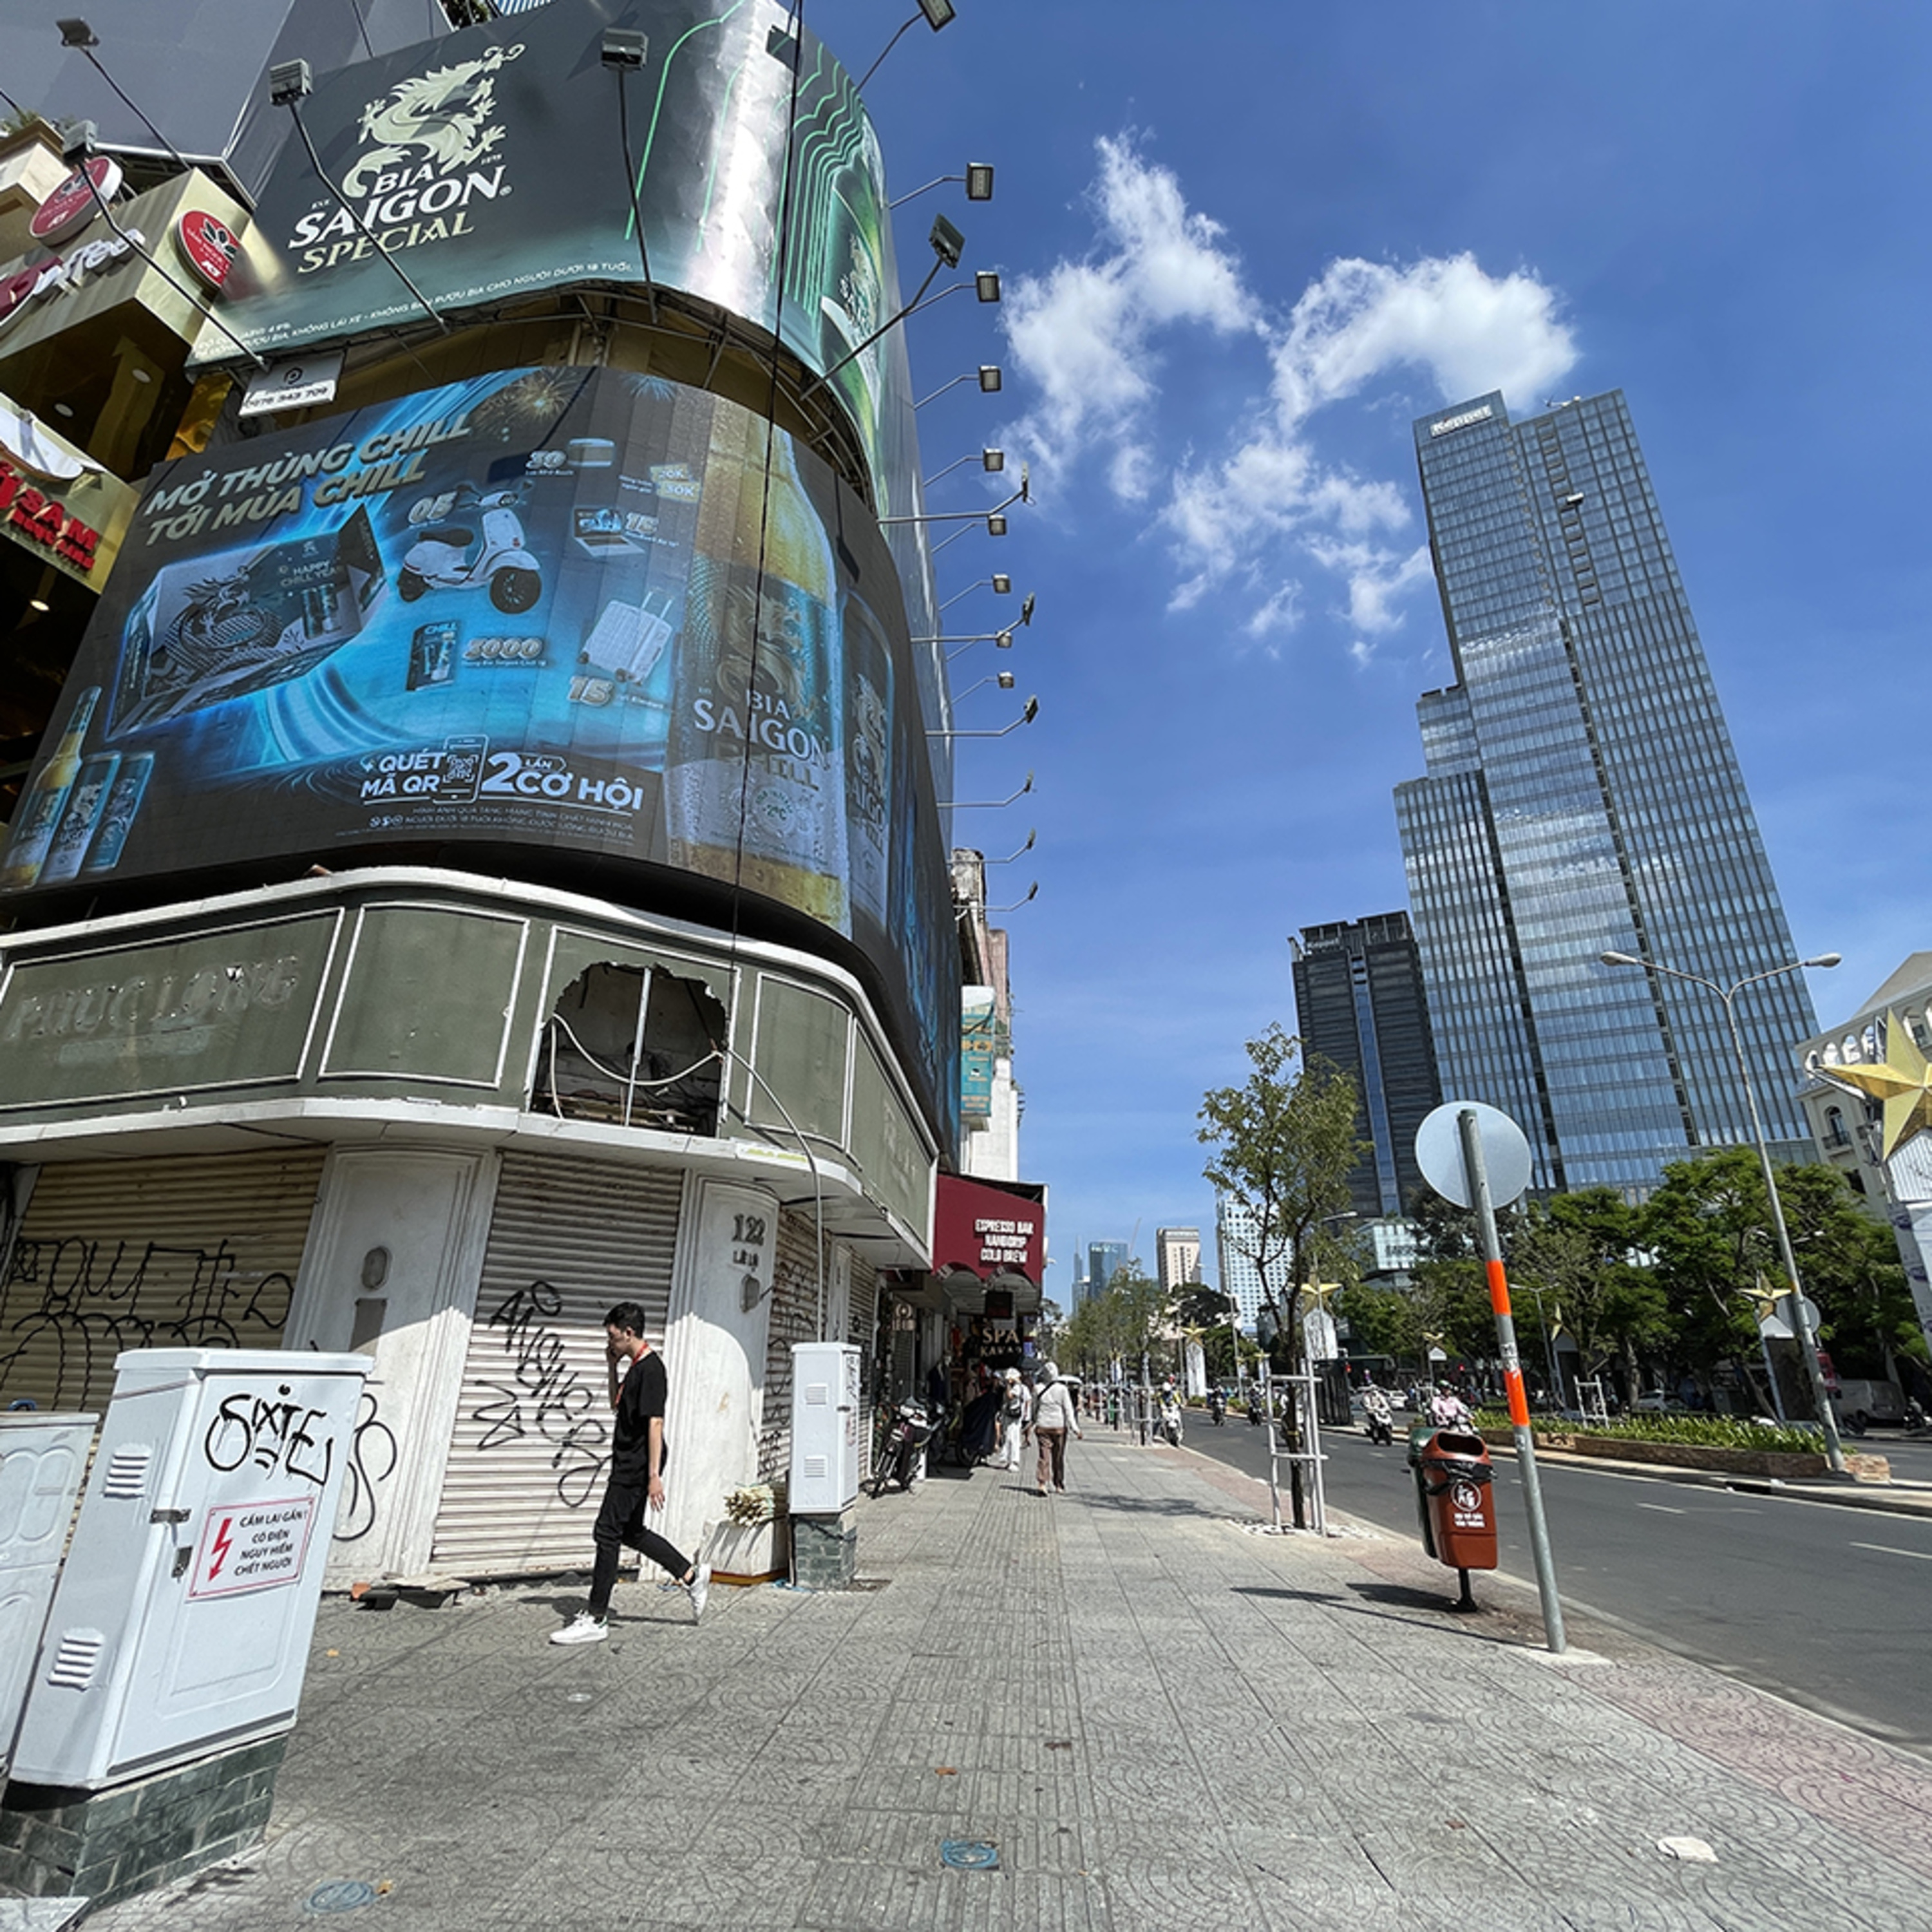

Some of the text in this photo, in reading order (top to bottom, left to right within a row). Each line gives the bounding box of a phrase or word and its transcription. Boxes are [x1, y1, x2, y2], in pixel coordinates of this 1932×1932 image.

[372, 163, 433, 196] BIA
[288, 165, 506, 249] SAIGON
[298, 211, 474, 273] SPECIAL
[144, 413, 474, 516] MỞ THÙNG CHILL
[211, 474, 301, 532] MÙA
[312, 448, 428, 507] CHILL
[293, 560, 331, 575] HAPPY
[566, 674, 614, 708] 15
[746, 689, 791, 720] BIA
[693, 698, 830, 772] SAIGON
[378, 748, 448, 773] QUÉT
[480, 752, 523, 793] 2
[360, 773, 440, 798] MÃ QR
[516, 770, 644, 811] CƠ HỘI
[732, 1213, 766, 1246] 122
[1017, 1221, 1034, 1235] BAR
[980, 1247, 1028, 1264] COLD BREW
[982, 1329, 1021, 1344] SPA
